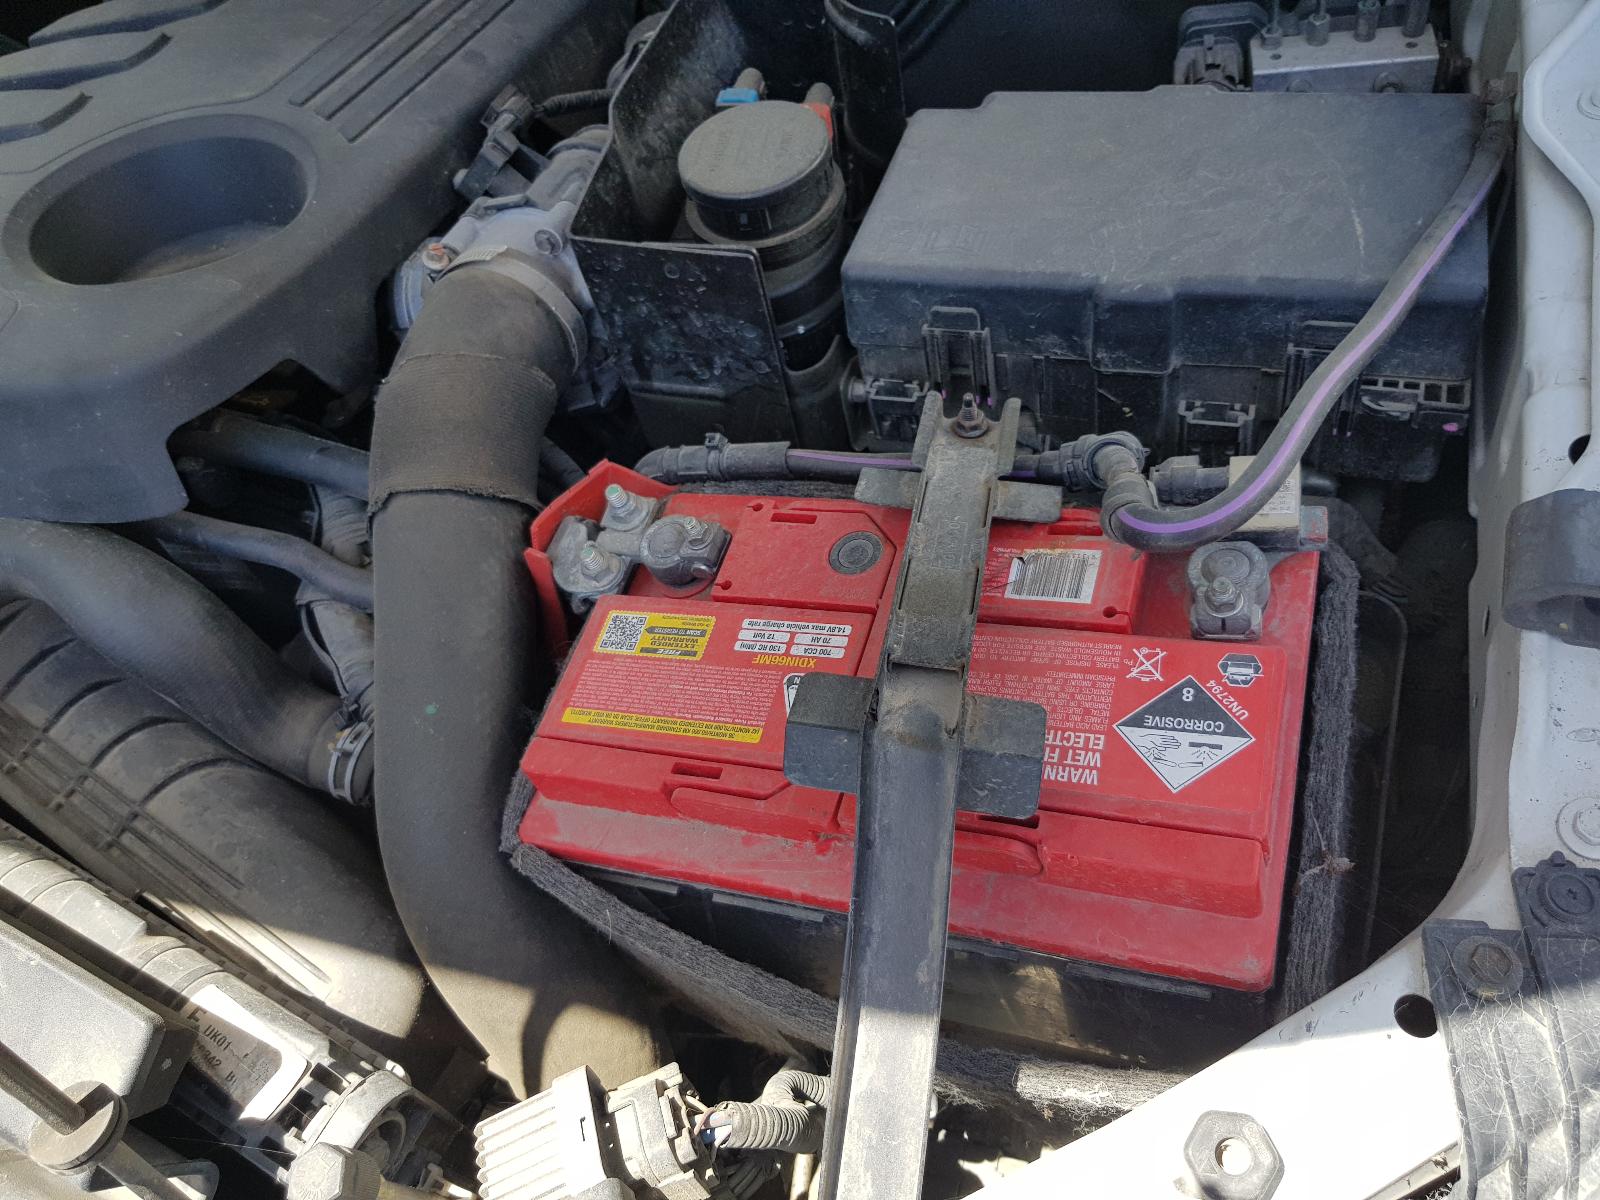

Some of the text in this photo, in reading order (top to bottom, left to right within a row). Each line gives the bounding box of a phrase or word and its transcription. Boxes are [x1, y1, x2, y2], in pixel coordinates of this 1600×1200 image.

[762, 620, 785, 629] charge
[786, 622, 809, 630] vehicle
[826, 625, 846, 633] 14.8V
[650, 635, 698, 643] WARRANTY
[650, 640, 696, 648] EXTENDED
[739, 641, 756, 649] (Min)
[1073, 647, 1112, 655] HOUSEHOLD
[1056, 652, 1092, 660] COLLECTION
[1094, 654, 1119, 662] BATTERY
[751, 654, 816, 667] XDIN66MF
[1122, 658, 1133, 666] Pb
[1084, 673, 1115, 681] PHYSICIAN
[982, 678, 1000, 686] FLUSH
[1066, 678, 1092, 686] AMOUNT
[999, 687, 1026, 695] CONTAINS
[1030, 689, 1054, 697] BATTERY
[1080, 687, 1113, 695] CONTACTS
[1181, 686, 1194, 702] 8
[1205, 679, 1248, 720] UN2794
[1079, 700, 1110, 709] CHARGING
[1056, 706, 1083, 714] OBJECTS
[1088, 708, 1109, 716] METAL
[588, 717, 613, 725] WARRANTY
[651, 717, 678, 725] WARRANTY
[1084, 715, 1108, 723] FLAMES
[1142, 714, 1225, 732] CORROSIVE
[656, 724, 682, 732] STANDARD
[679, 720, 704, 728] EXTENDED
[1062, 748, 1101, 767] WET
